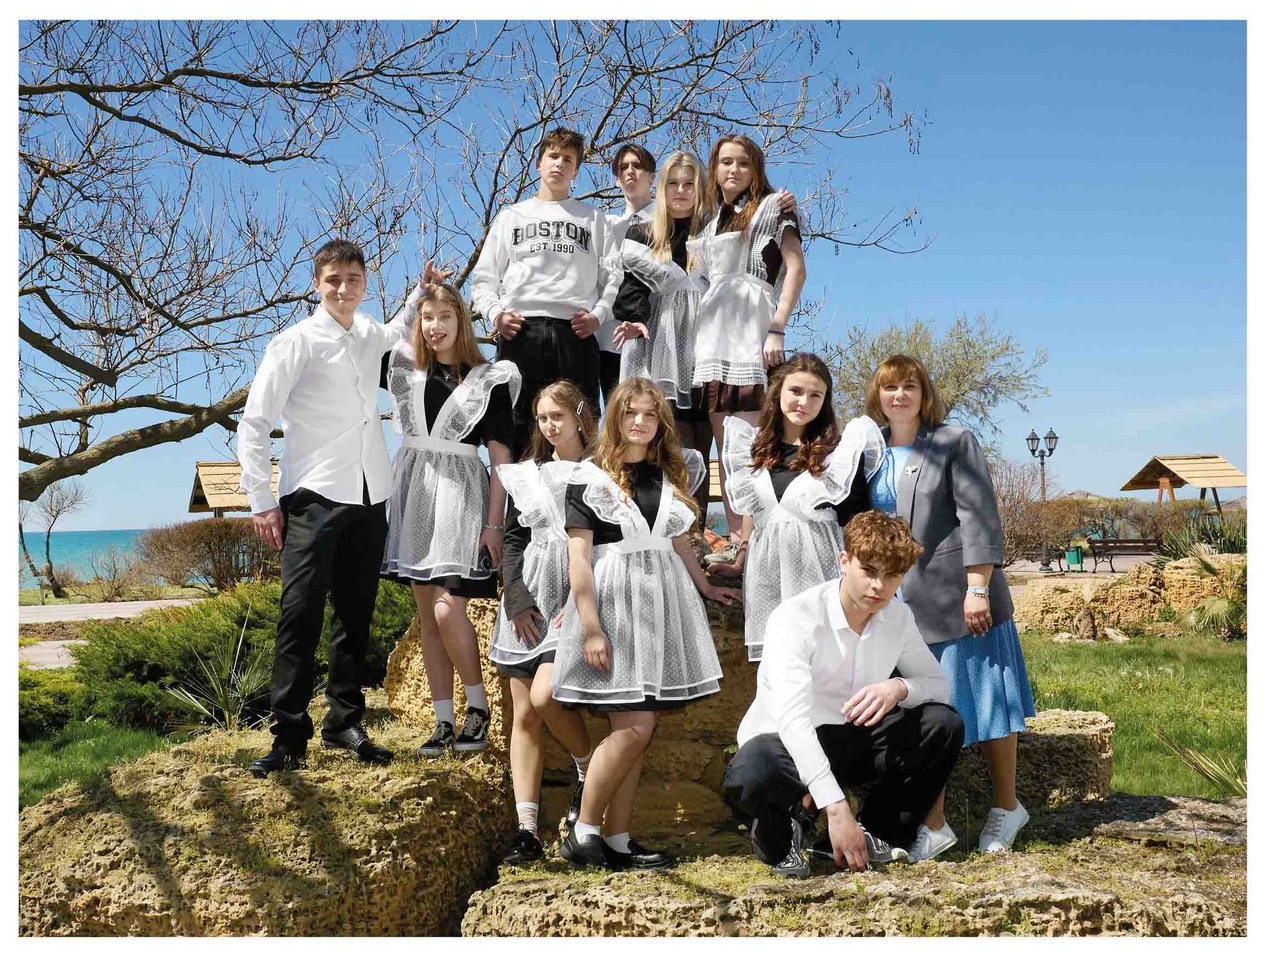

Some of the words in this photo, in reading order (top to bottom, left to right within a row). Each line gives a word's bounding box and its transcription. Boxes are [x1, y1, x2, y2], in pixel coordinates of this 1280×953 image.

[512, 220, 592, 253] BOSTON
[529, 242, 551, 253] EST.
[553, 243, 575, 254] 1990
